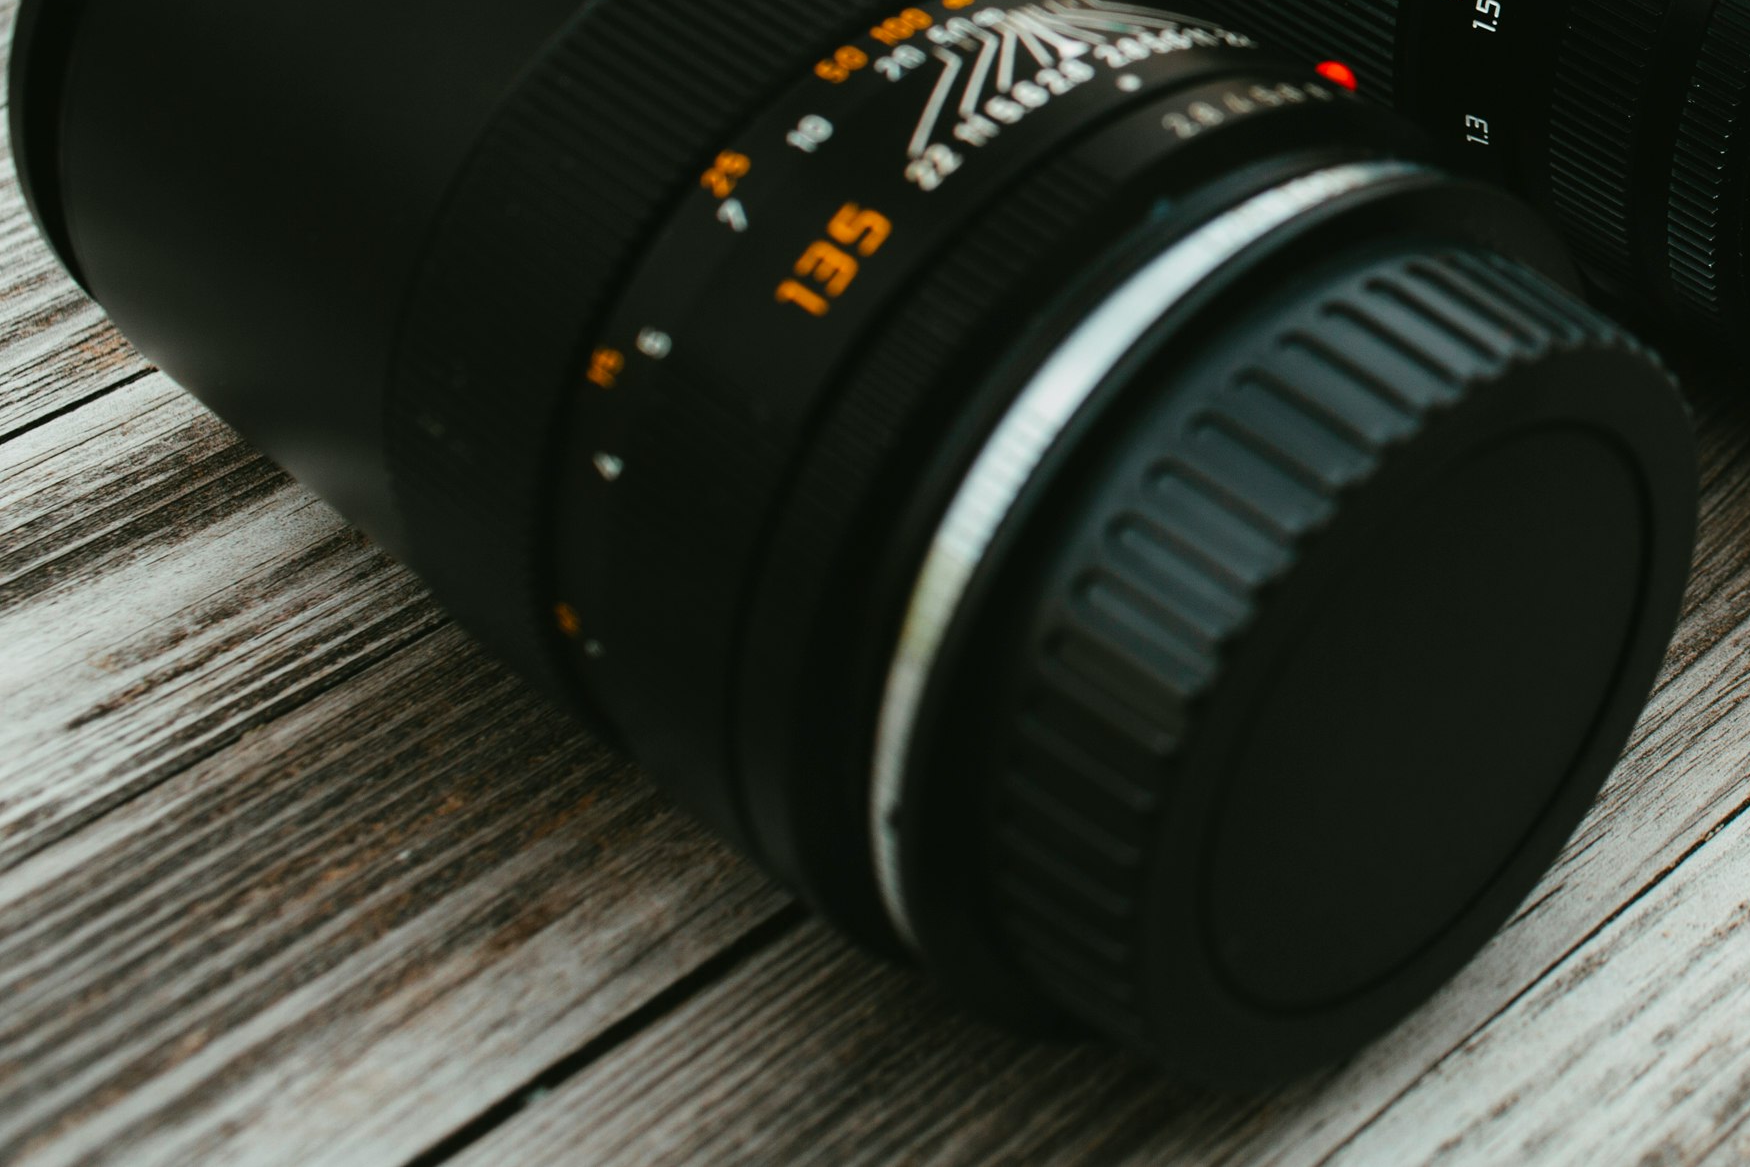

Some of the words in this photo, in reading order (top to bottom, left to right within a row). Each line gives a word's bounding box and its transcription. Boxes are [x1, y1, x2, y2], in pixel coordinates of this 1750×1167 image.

[1161, 100, 1225, 140] 2.8
[1465, 114, 1489, 145] 1.3
[716, 199, 749, 232] 7
[786, 114, 834, 153] 10
[904, 145, 962, 191] 22
[773, 201, 893, 318] 135
